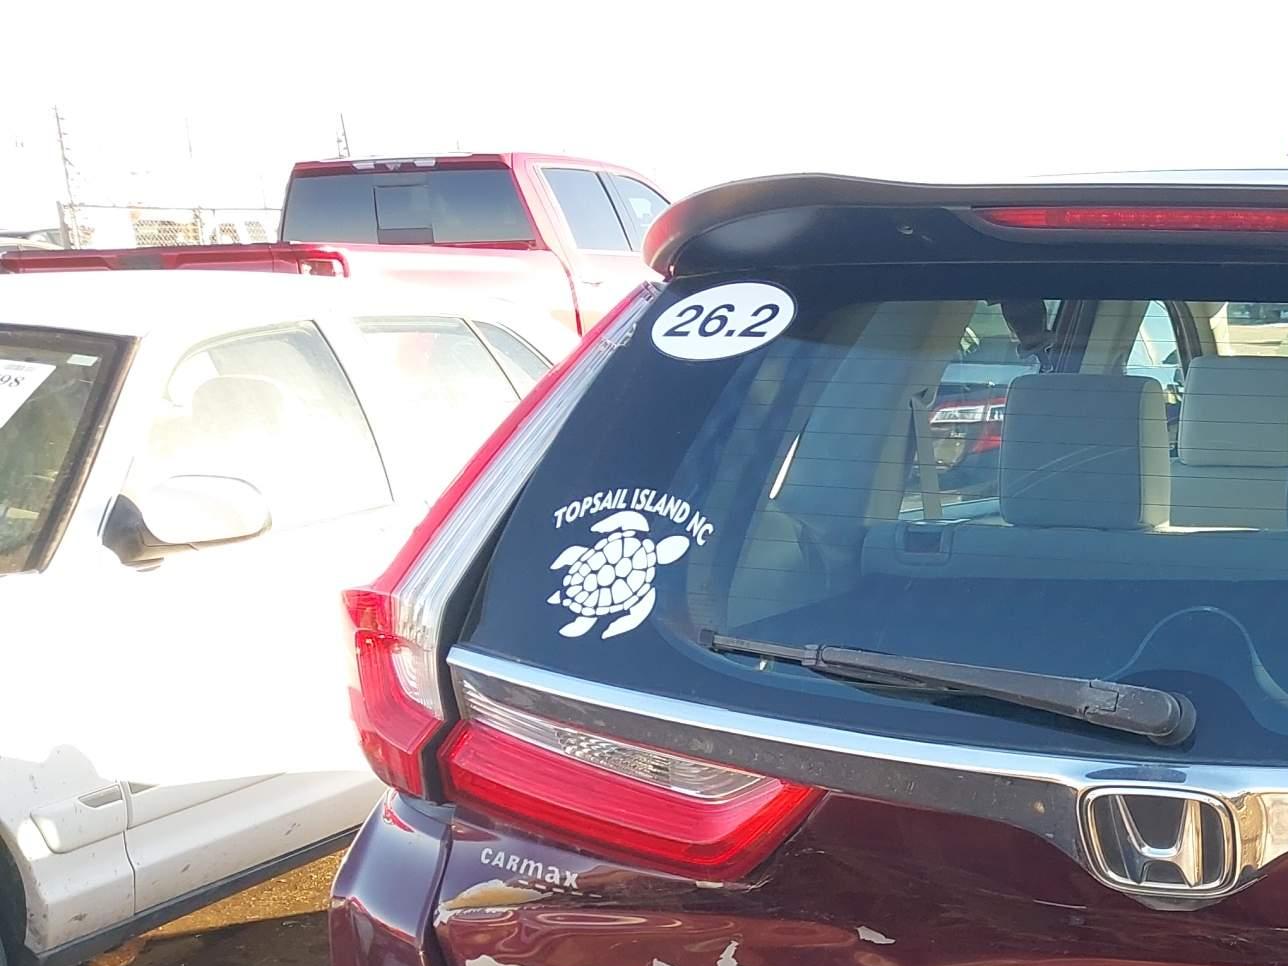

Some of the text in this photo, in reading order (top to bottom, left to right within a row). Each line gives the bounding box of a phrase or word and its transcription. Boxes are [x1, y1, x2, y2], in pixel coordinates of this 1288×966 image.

[662, 303, 780, 337] 26.2
[553, 488, 714, 546] TOPSAIL ISLAND NC
